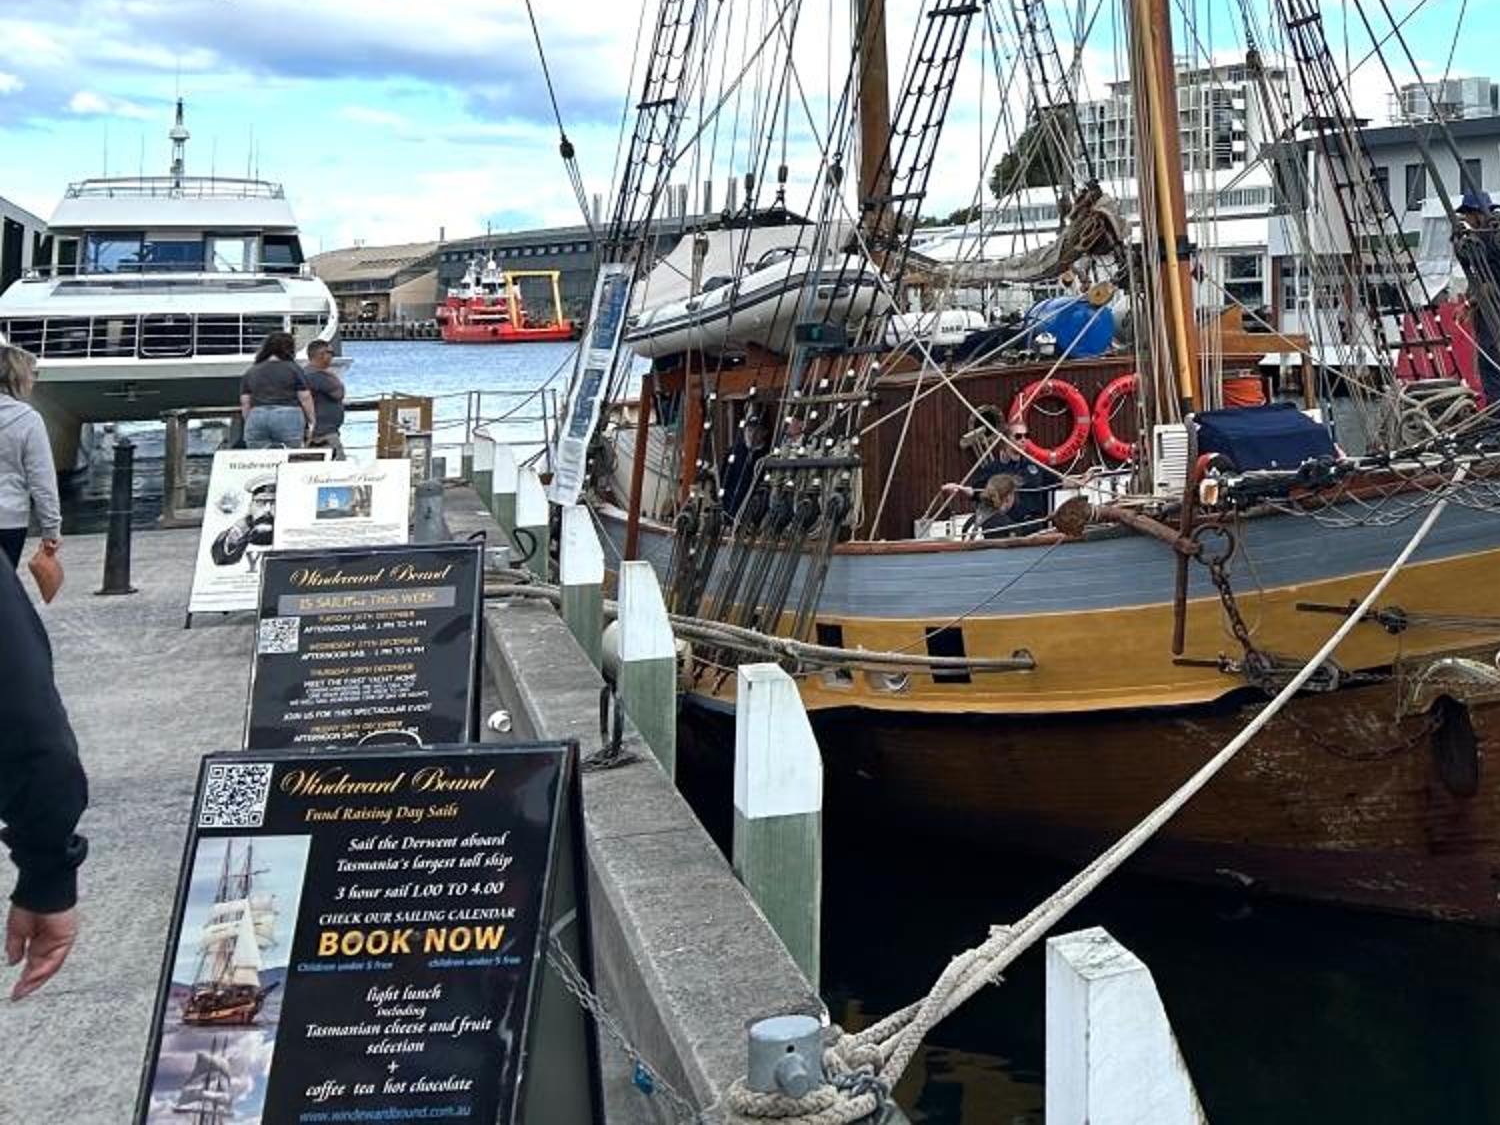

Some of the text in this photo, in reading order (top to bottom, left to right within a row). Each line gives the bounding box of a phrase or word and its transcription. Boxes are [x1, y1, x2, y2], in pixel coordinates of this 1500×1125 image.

[390, 564, 451, 581] Bound
[303, 625, 350, 634] AFTERNOON
[293, 733, 341, 743] AFTERNOON
[280, 766, 496, 795] Windeward Bound
[305, 802, 460, 824] Fund Raising Day Sails
[348, 830, 511, 852] Sail the Derwent aboard
[336, 849, 513, 874] Tasmania's largest tall ship
[336, 887, 345, 900] 3
[348, 884, 382, 899] hour
[384, 882, 412, 898] sail
[447, 882, 467, 896] TO
[471, 881, 505, 895] 4.00
[319, 907, 516, 925] CHECK OUR SAILING CALENDAR
[318, 925, 505, 956] BOOK NOW
[366, 983, 442, 1008] light lunch
[376, 1005, 427, 1020] including
[306, 1015, 492, 1038] Tasmanian cheese and fruit
[366, 1038, 425, 1055] selection
[387, 1059, 400, 1073] +
[305, 1075, 473, 1102] coffee tea hot chocolate
